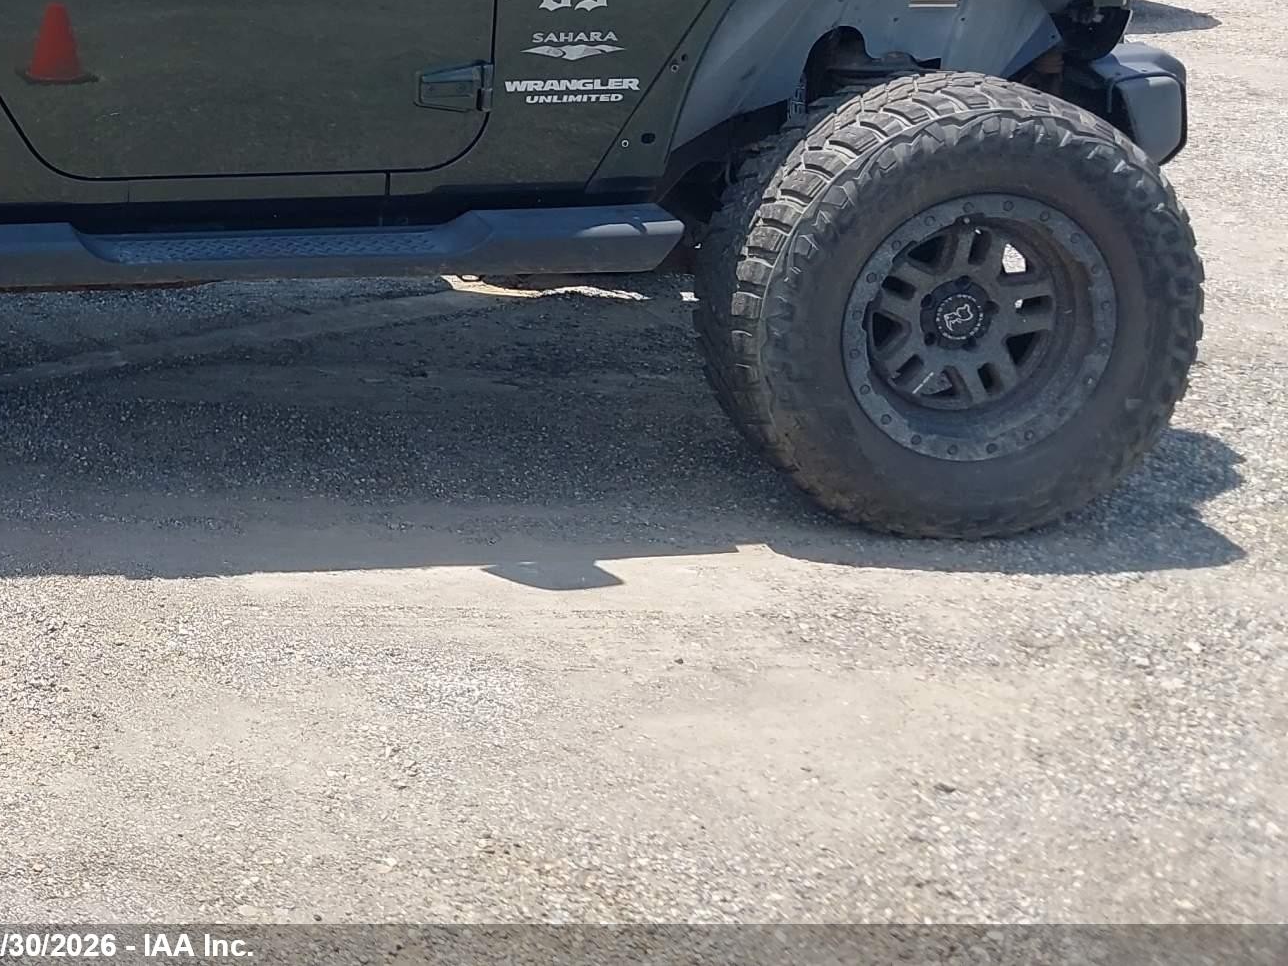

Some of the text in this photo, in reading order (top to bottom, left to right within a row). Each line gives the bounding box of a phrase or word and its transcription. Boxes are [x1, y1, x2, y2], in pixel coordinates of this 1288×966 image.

[531, 31, 619, 43] SAHARA
[504, 78, 641, 92] WRANGLER
[525, 93, 624, 104] UNLIMITED
